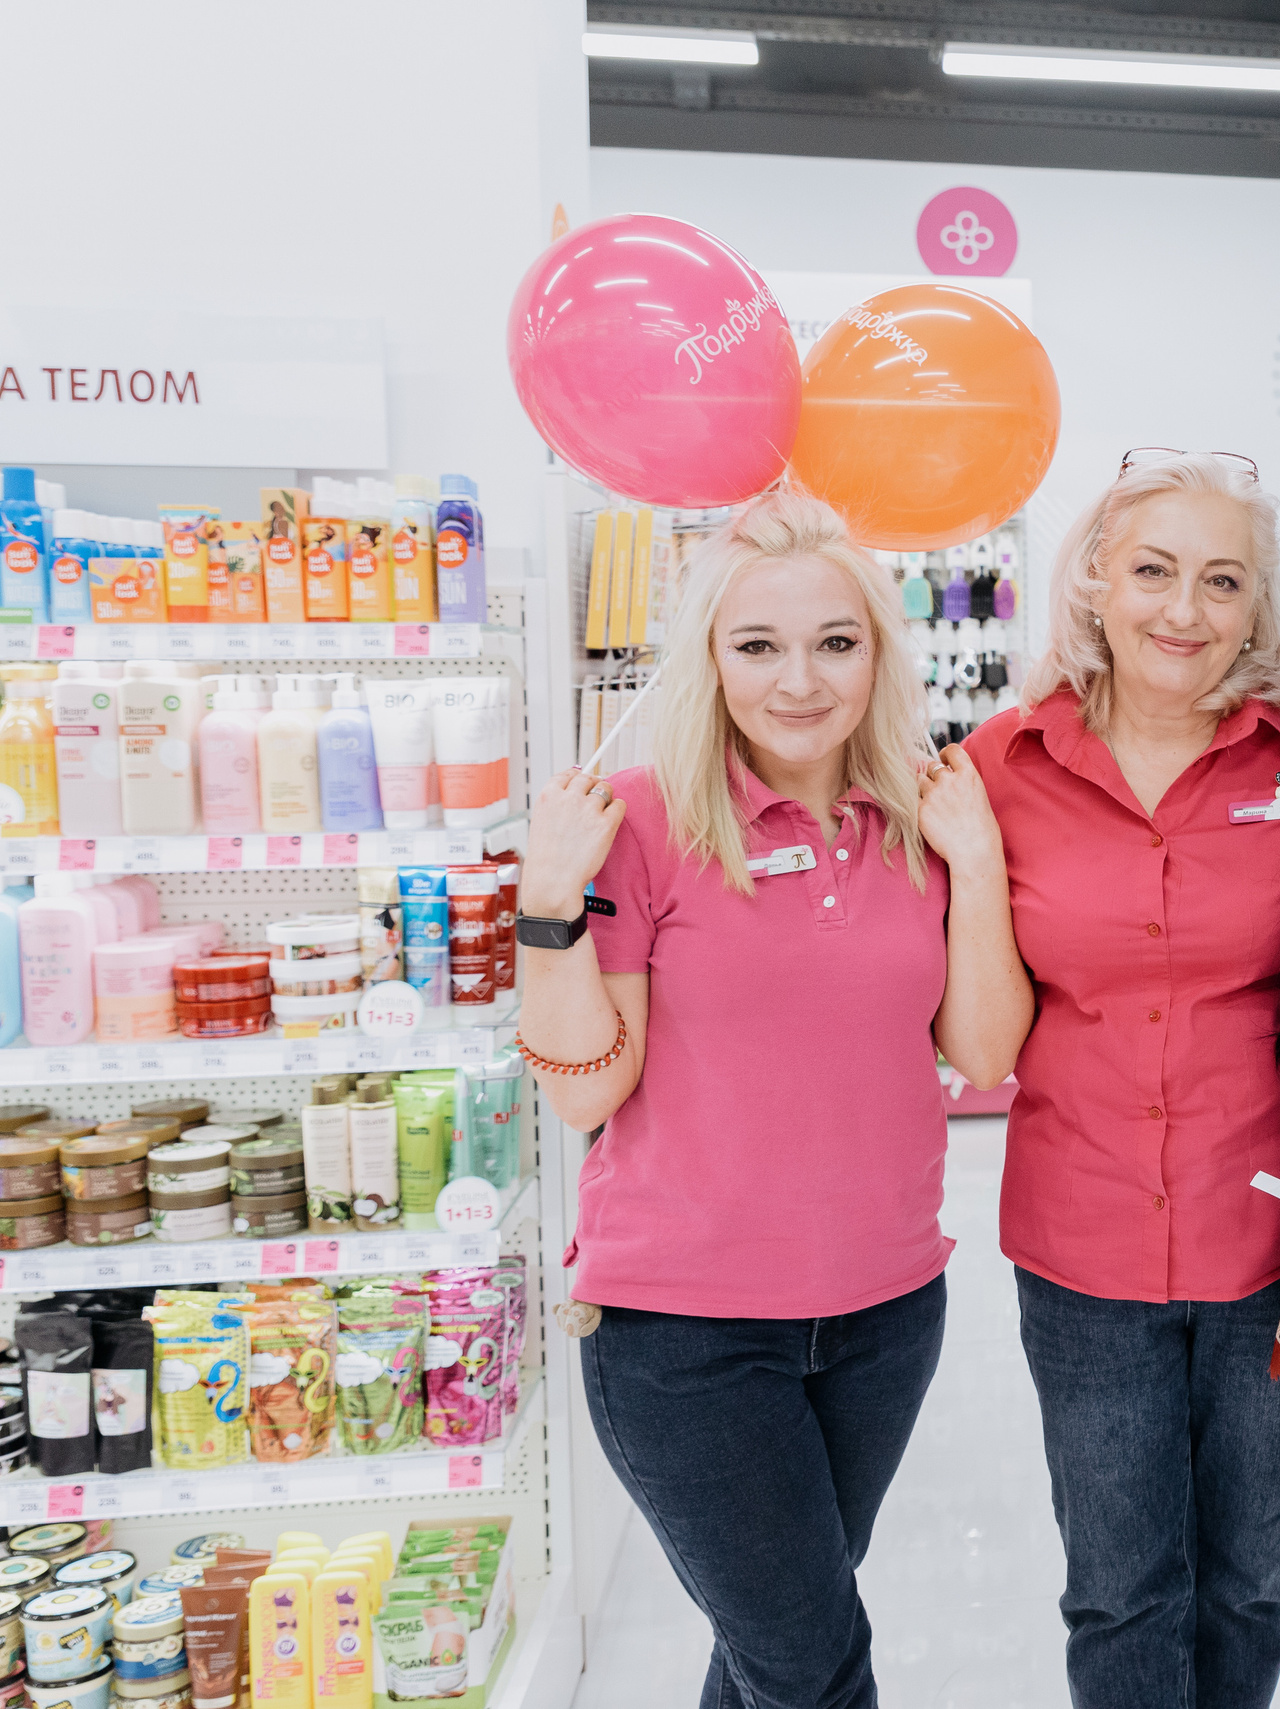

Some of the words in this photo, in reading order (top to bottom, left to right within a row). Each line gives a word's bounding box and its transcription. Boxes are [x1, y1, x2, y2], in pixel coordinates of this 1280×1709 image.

[42, 366, 201, 404] ТЕЛОМ
[367, 1010, 415, 1027] 1+1=3
[445, 1204, 493, 1222] 1+1=3
